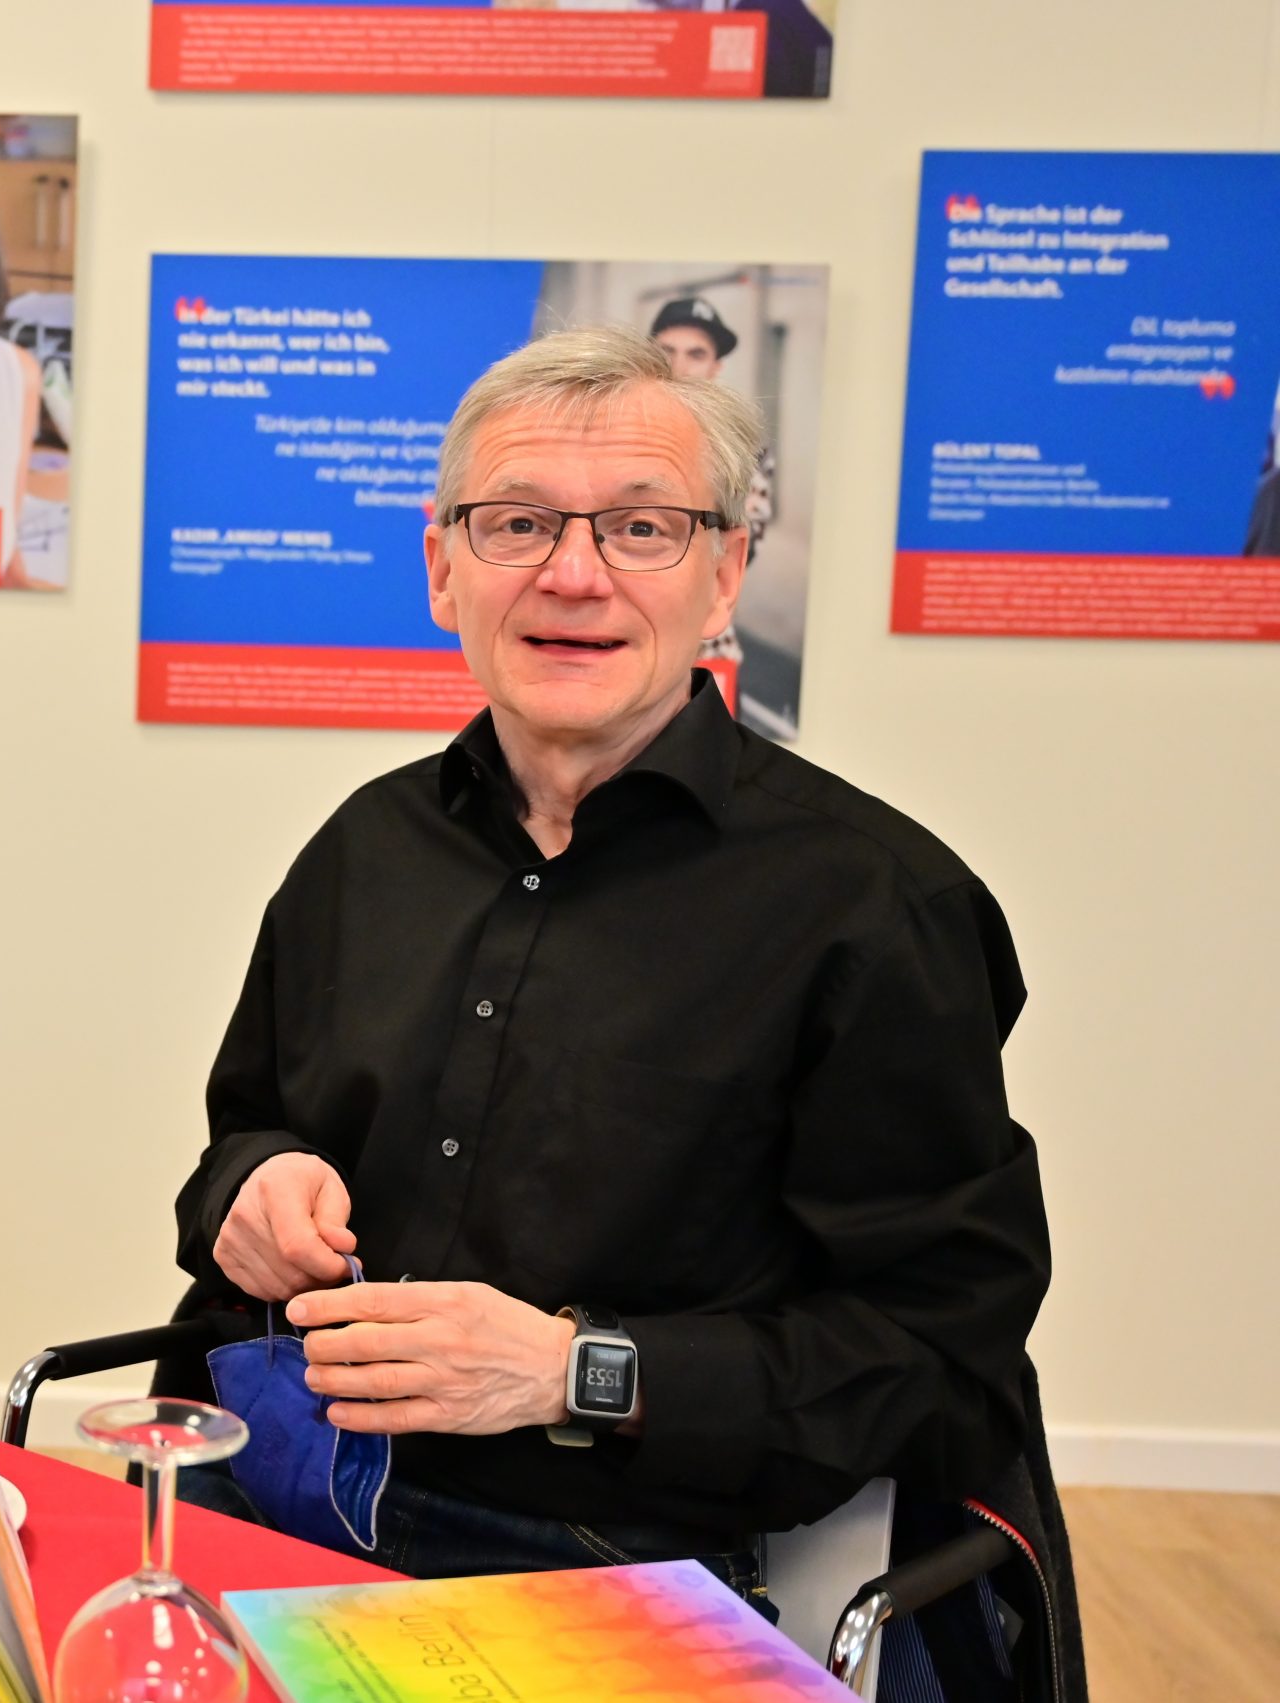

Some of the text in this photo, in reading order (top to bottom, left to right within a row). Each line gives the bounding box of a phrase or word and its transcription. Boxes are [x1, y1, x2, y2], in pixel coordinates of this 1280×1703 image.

[986, 204, 1061, 227] Sprache
[1063, 206, 1087, 224] ist
[1089, 205, 1123, 225] der
[949, 228, 1169, 254] Schlüssel zu Integration
[946, 253, 1128, 275] und Teilhabe an der
[944, 277, 1063, 298] Gesellschaft.
[201, 305, 231, 324] der
[233, 306, 290, 326] Türkei
[291, 306, 341, 327] hätte
[342, 308, 372, 327] ich
[178, 331, 391, 354] nie erkannt, wer ich bin,
[177, 354, 376, 376] was ich will und was in
[176, 379, 209, 396] mir
[587, 1367, 622, 1388] 1553
[399, 1614, 466, 1667] Berlin
